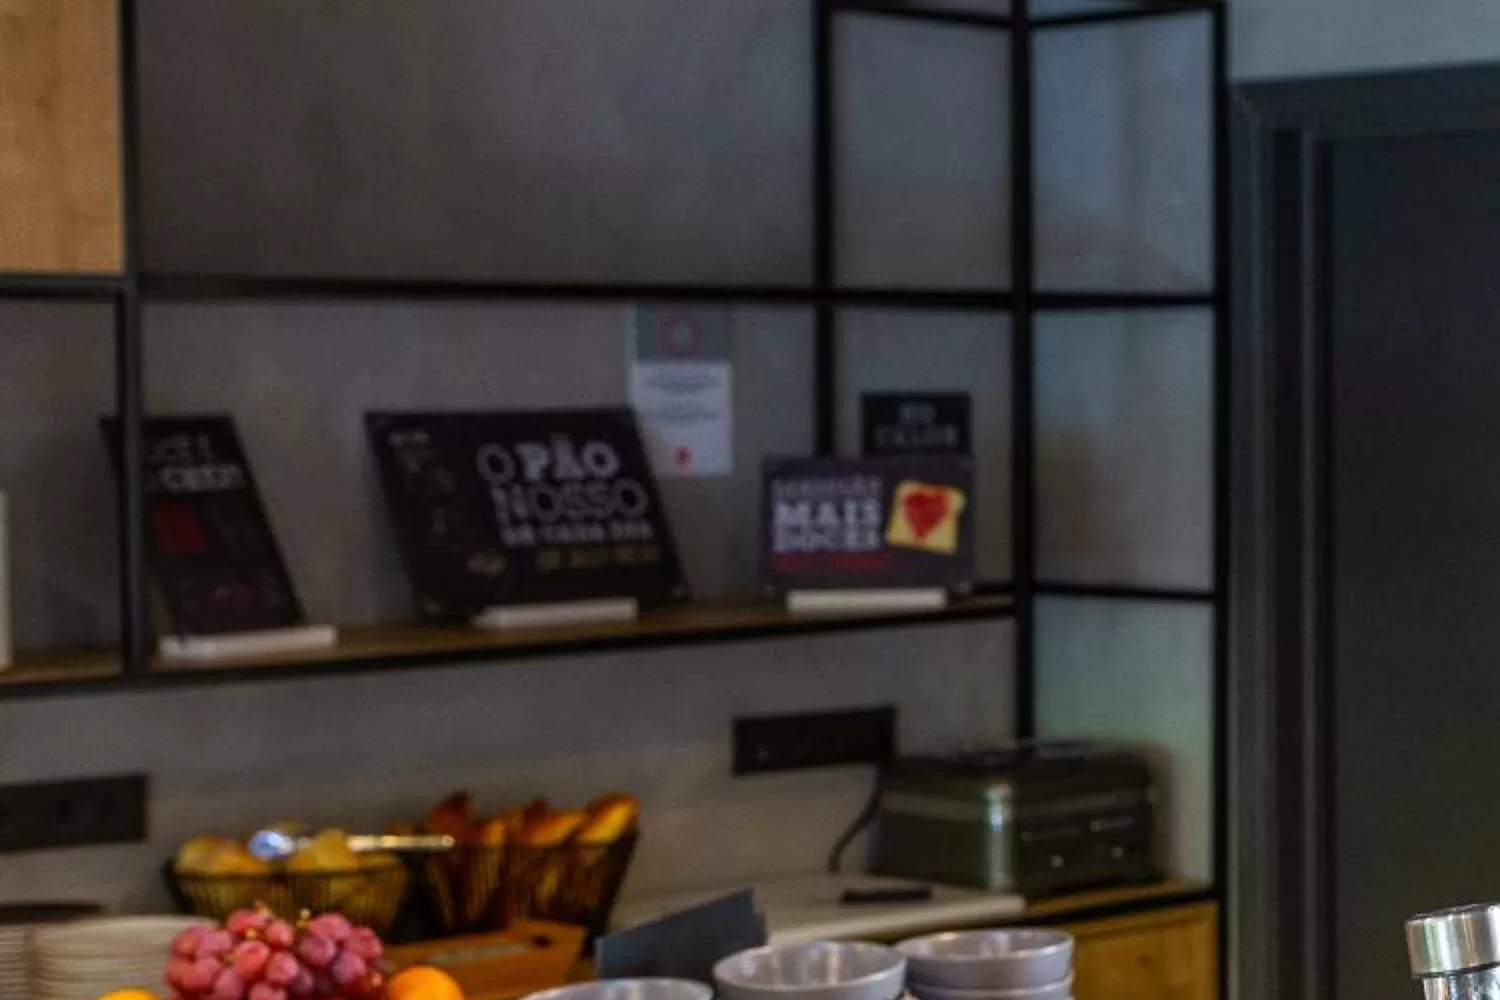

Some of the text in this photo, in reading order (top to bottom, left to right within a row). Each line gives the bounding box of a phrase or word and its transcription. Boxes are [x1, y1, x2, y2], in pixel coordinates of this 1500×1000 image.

[476, 432, 622, 484] O PÃO
[490, 477, 651, 525] NOSSO
[772, 499, 882, 525] MAIS
